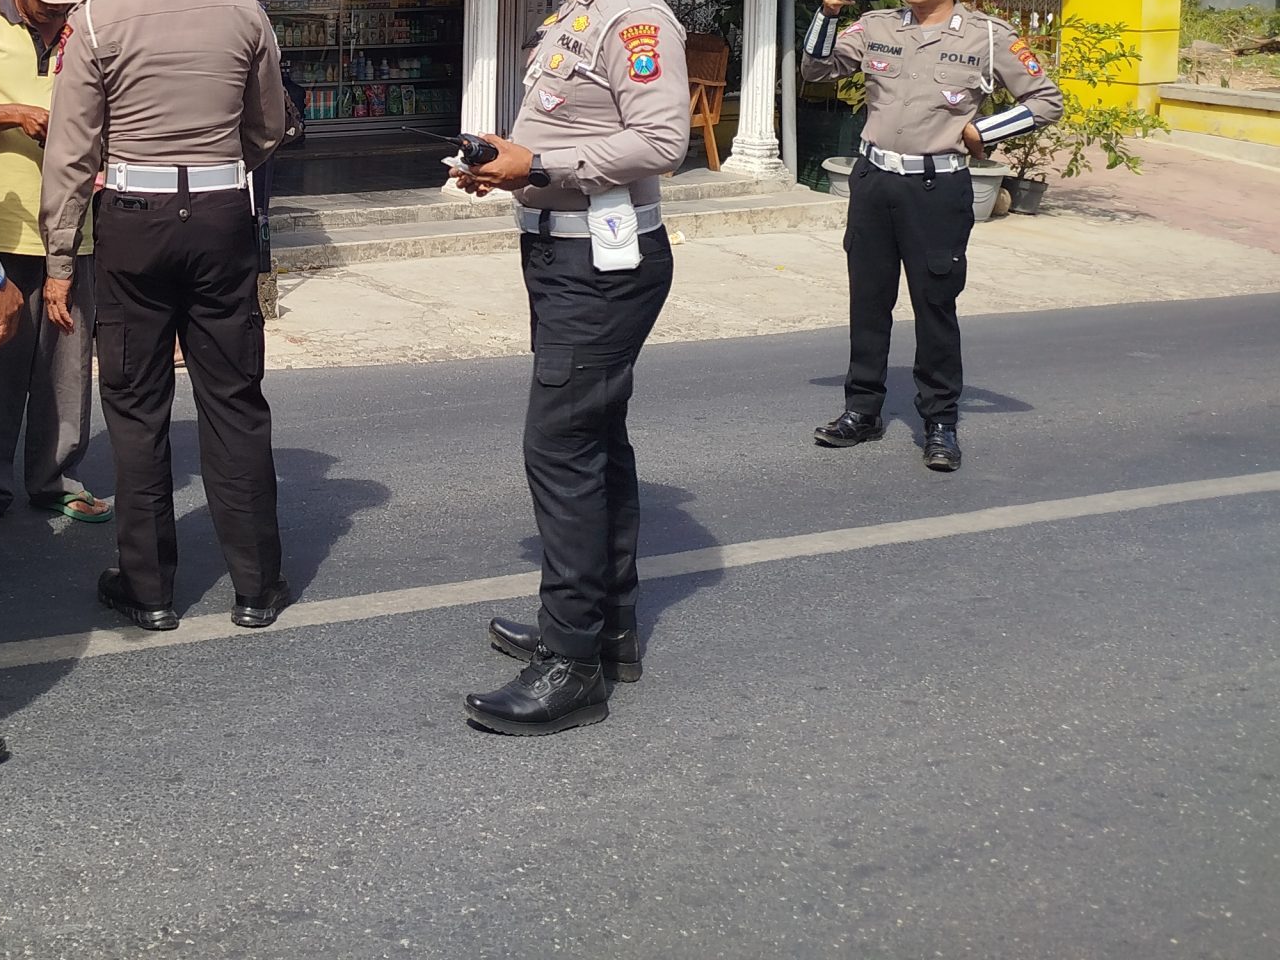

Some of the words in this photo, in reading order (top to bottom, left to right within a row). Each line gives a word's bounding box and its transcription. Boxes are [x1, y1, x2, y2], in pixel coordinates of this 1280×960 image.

[556, 33, 583, 55] POLRI
[867, 42, 903, 56] HERDANI
[940, 52, 981, 67] POLRI
